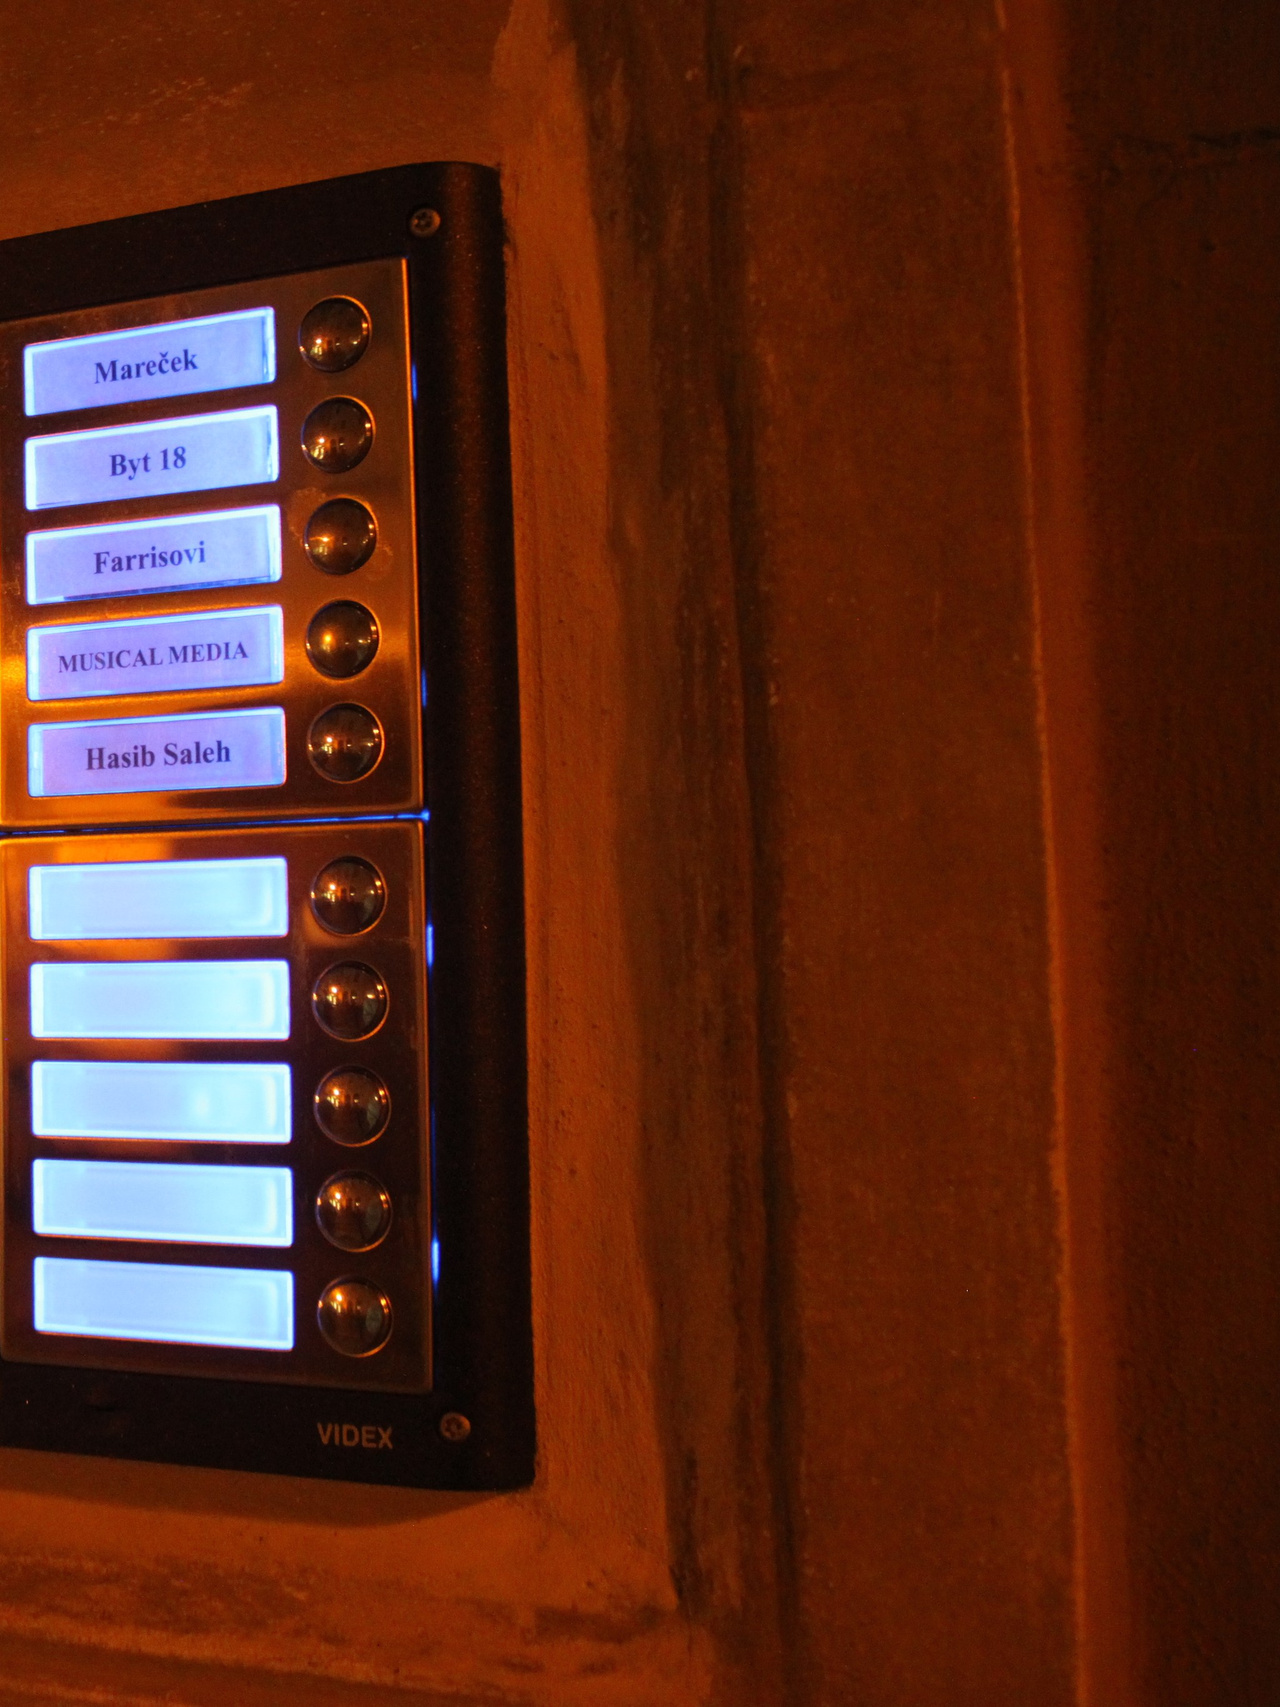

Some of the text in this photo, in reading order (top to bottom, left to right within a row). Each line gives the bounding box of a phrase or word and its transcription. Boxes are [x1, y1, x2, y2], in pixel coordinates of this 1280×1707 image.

[94, 349, 199, 384] Mareček
[109, 446, 187, 481] Byt 18
[93, 540, 206, 575] Farrisovi
[58, 641, 249, 674] MUSICAL MEDIA
[86, 739, 232, 771] Hasib Saleh
[316, 1423, 394, 1450] VIDEX
